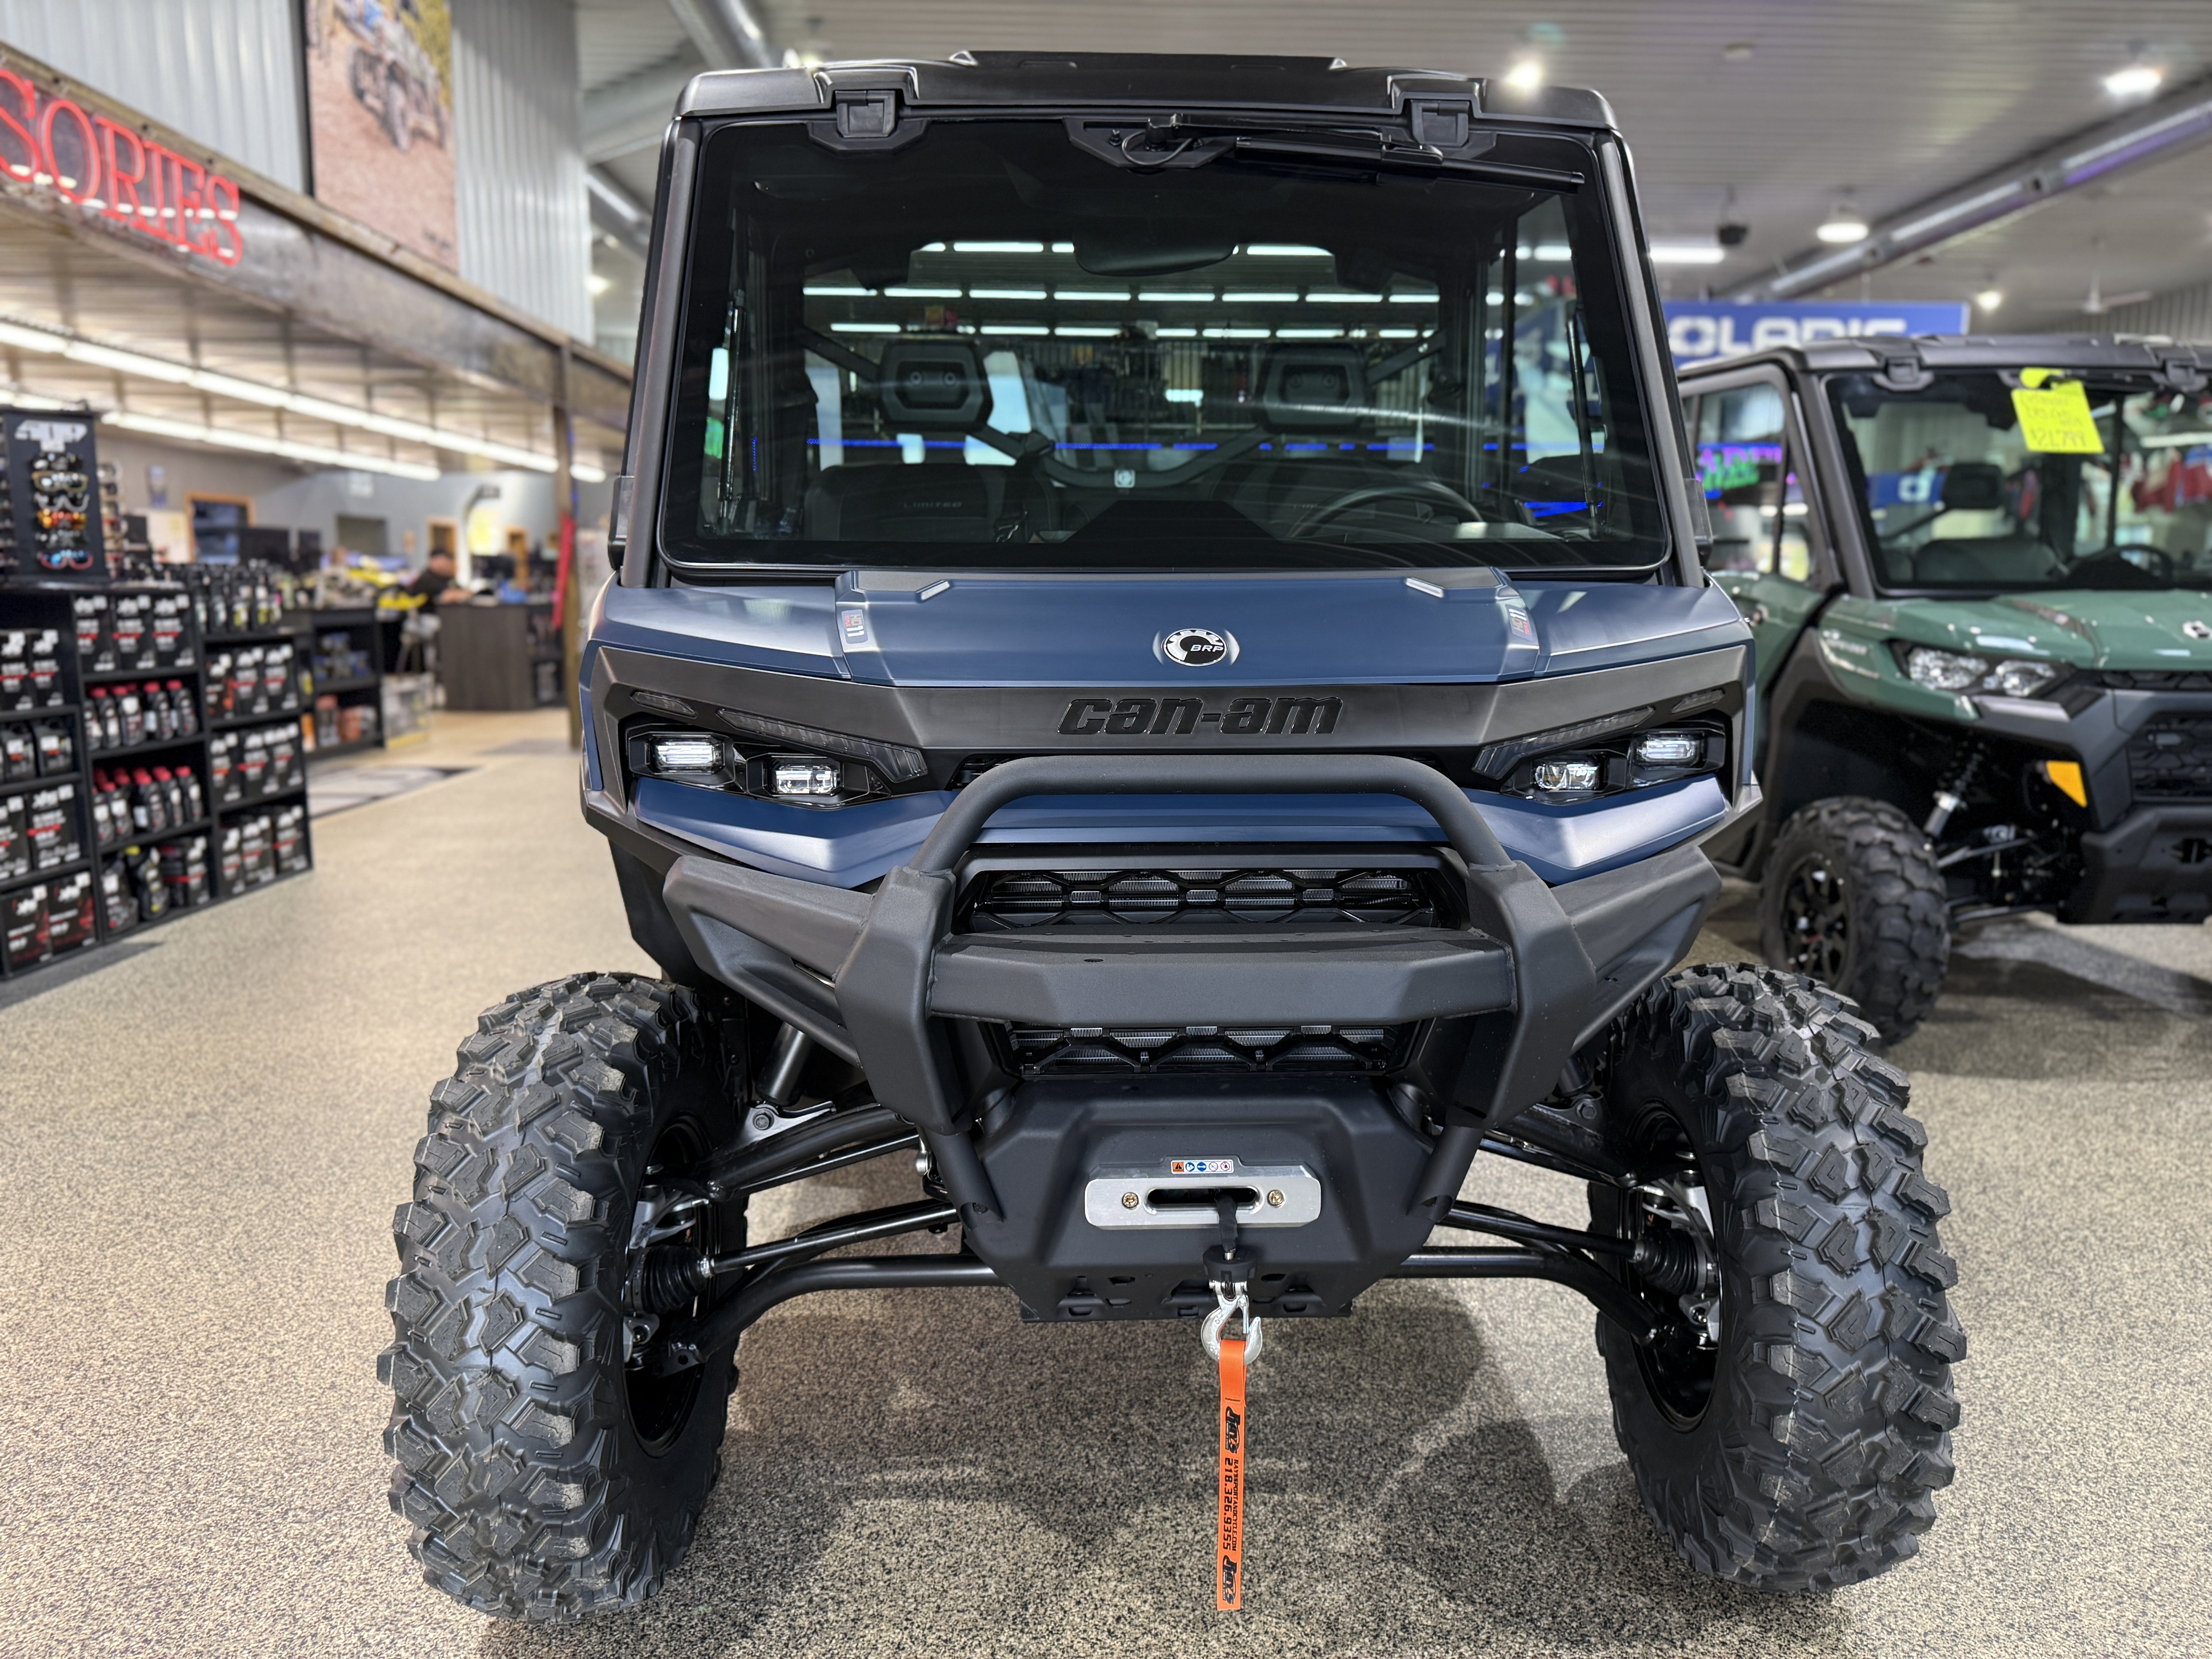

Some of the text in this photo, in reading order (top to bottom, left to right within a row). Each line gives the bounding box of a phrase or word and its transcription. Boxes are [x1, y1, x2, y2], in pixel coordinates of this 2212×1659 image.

[1190, 644, 1224, 653] BRP
[1057, 697, 1344, 735] can-am
[1223, 1457, 1233, 1550] 218.326.9355
